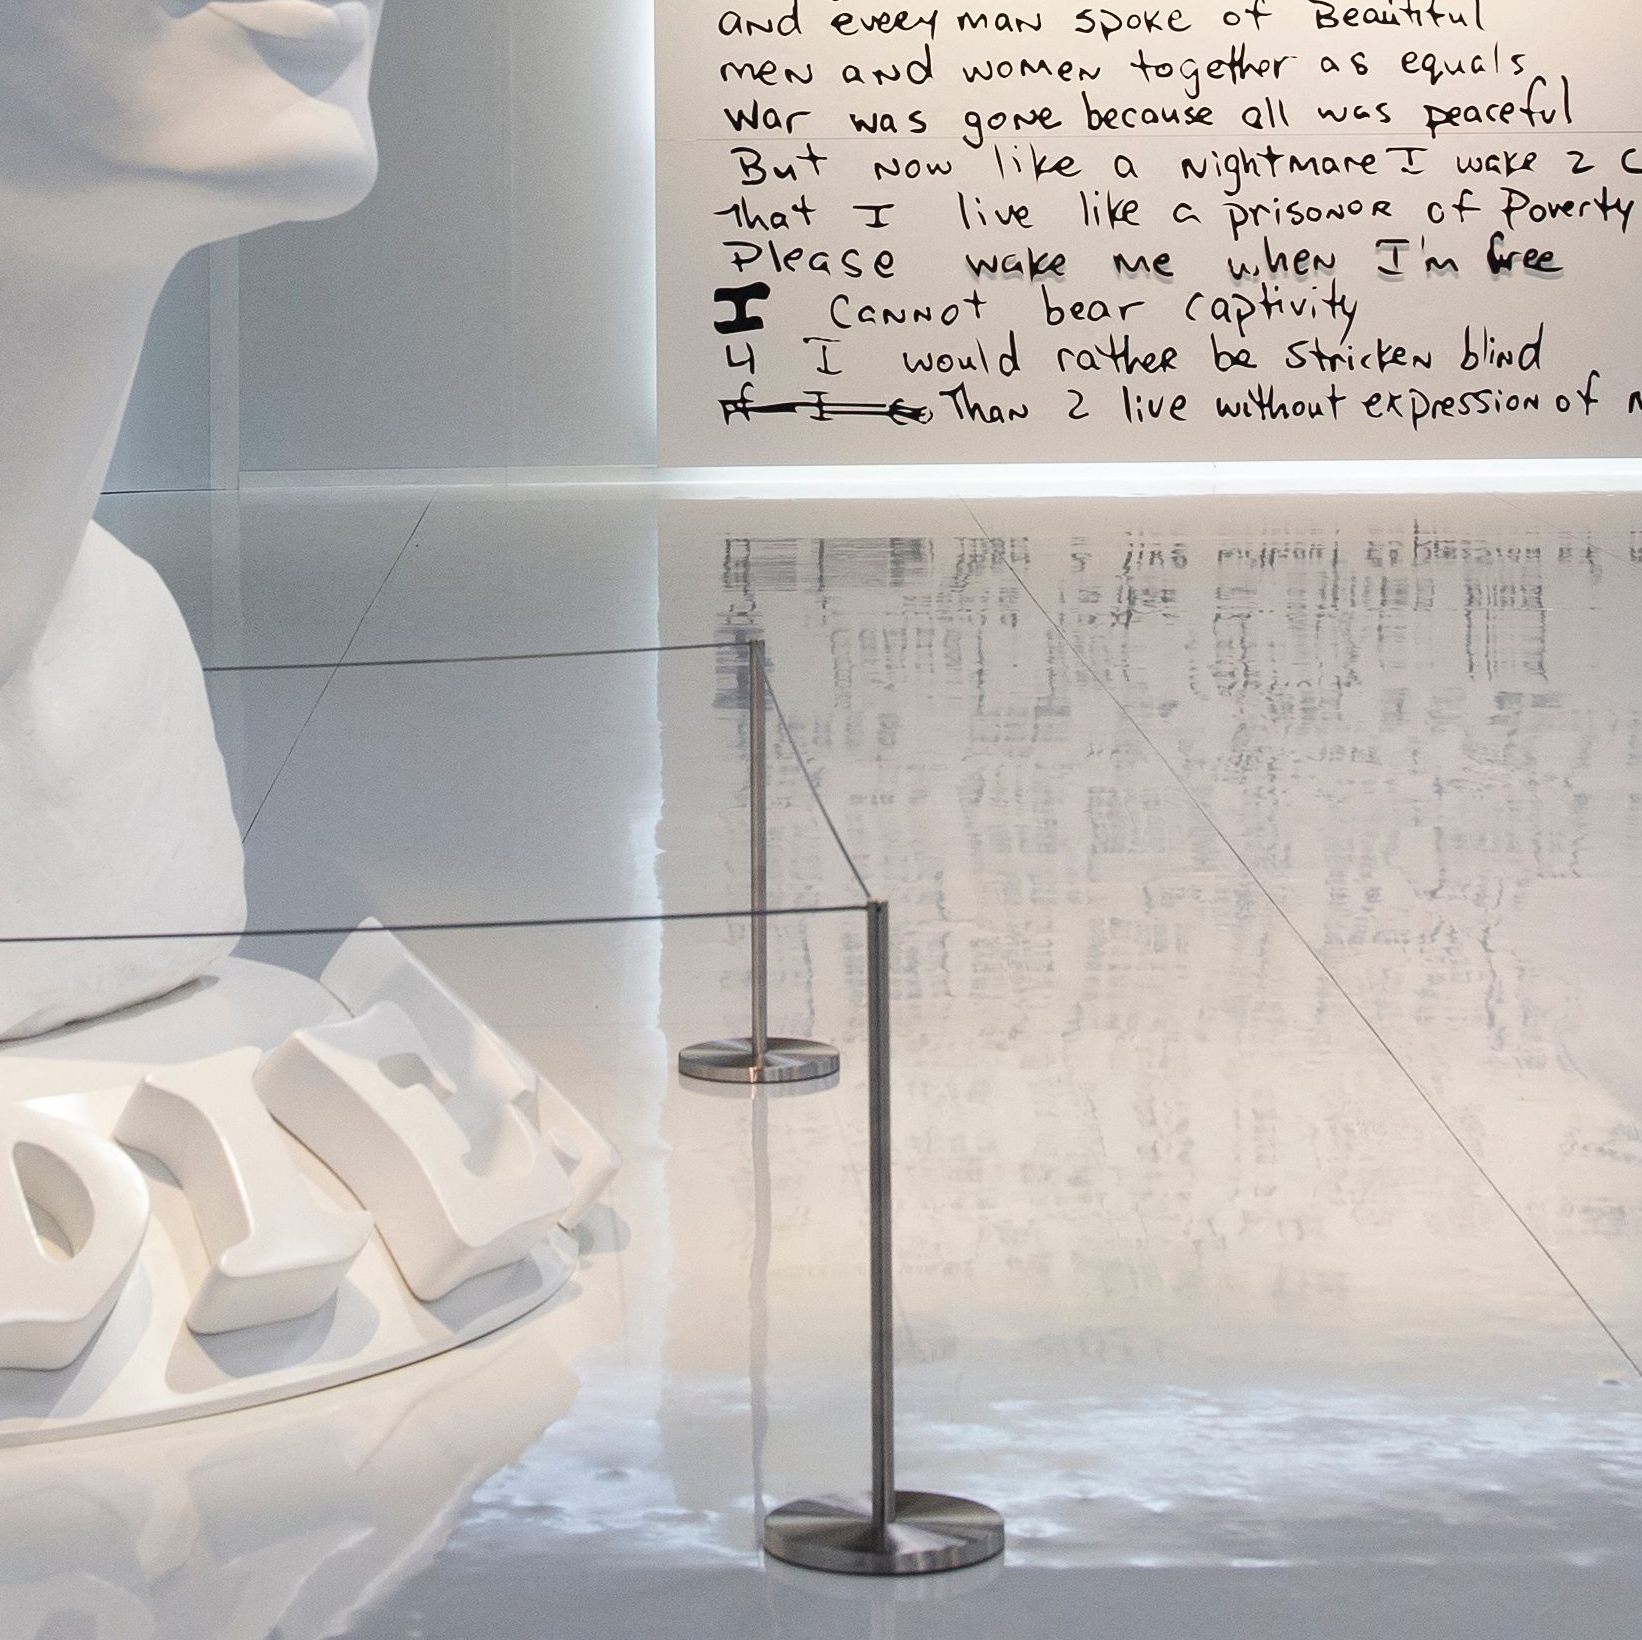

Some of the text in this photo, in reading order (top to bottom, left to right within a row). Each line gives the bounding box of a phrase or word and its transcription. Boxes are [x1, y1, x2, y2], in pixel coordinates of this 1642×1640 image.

[956, 11, 1042, 33] man
[1075, 8, 1192, 42] spoke
[719, 59, 813, 86] men
[842, 43, 934, 86] and
[1130, 42, 1289, 100] together
[1320, 51, 1369, 76] as
[1401, 43, 1525, 86] equals
[849, 110, 927, 134] was
[962, 106, 1063, 150] gone
[1081, 90, 1214, 131] because
[1241, 96, 1289, 130] all
[1317, 102, 1392, 124] was
[1423, 74, 1573, 140] peaceful
[994, 143, 1082, 181] like
[1114, 154, 1139, 179] a
[1385, 147, 1428, 175] I
[1456, 150, 1538, 178] wake
[1566, 150, 1595, 175] 2
[852, 203, 895, 229] I
[957, 191, 1033, 230] live
[1079, 190, 1140, 230] like
[1172, 202, 1202, 224] a
[1427, 188, 1482, 224] of
[1499, 185, 1635, 234] Poverty
[722, 230, 1564, 282] Please wake me when I'm free
[713, 281, 771, 335] I
[1040, 283, 1145, 326] bear
[802, 336, 843, 376] I
[902, 329, 1021, 378] would
[1057, 333, 1178, 375] rather
[1210, 332, 1258, 373] be
[1460, 321, 1544, 372] blind
[1067, 389, 1090, 420] 2
[1122, 385, 1187, 424] live
[1215, 383, 1347, 421] without
[1361, 387, 1539, 432] expression
[1555, 369, 1601, 416] of
